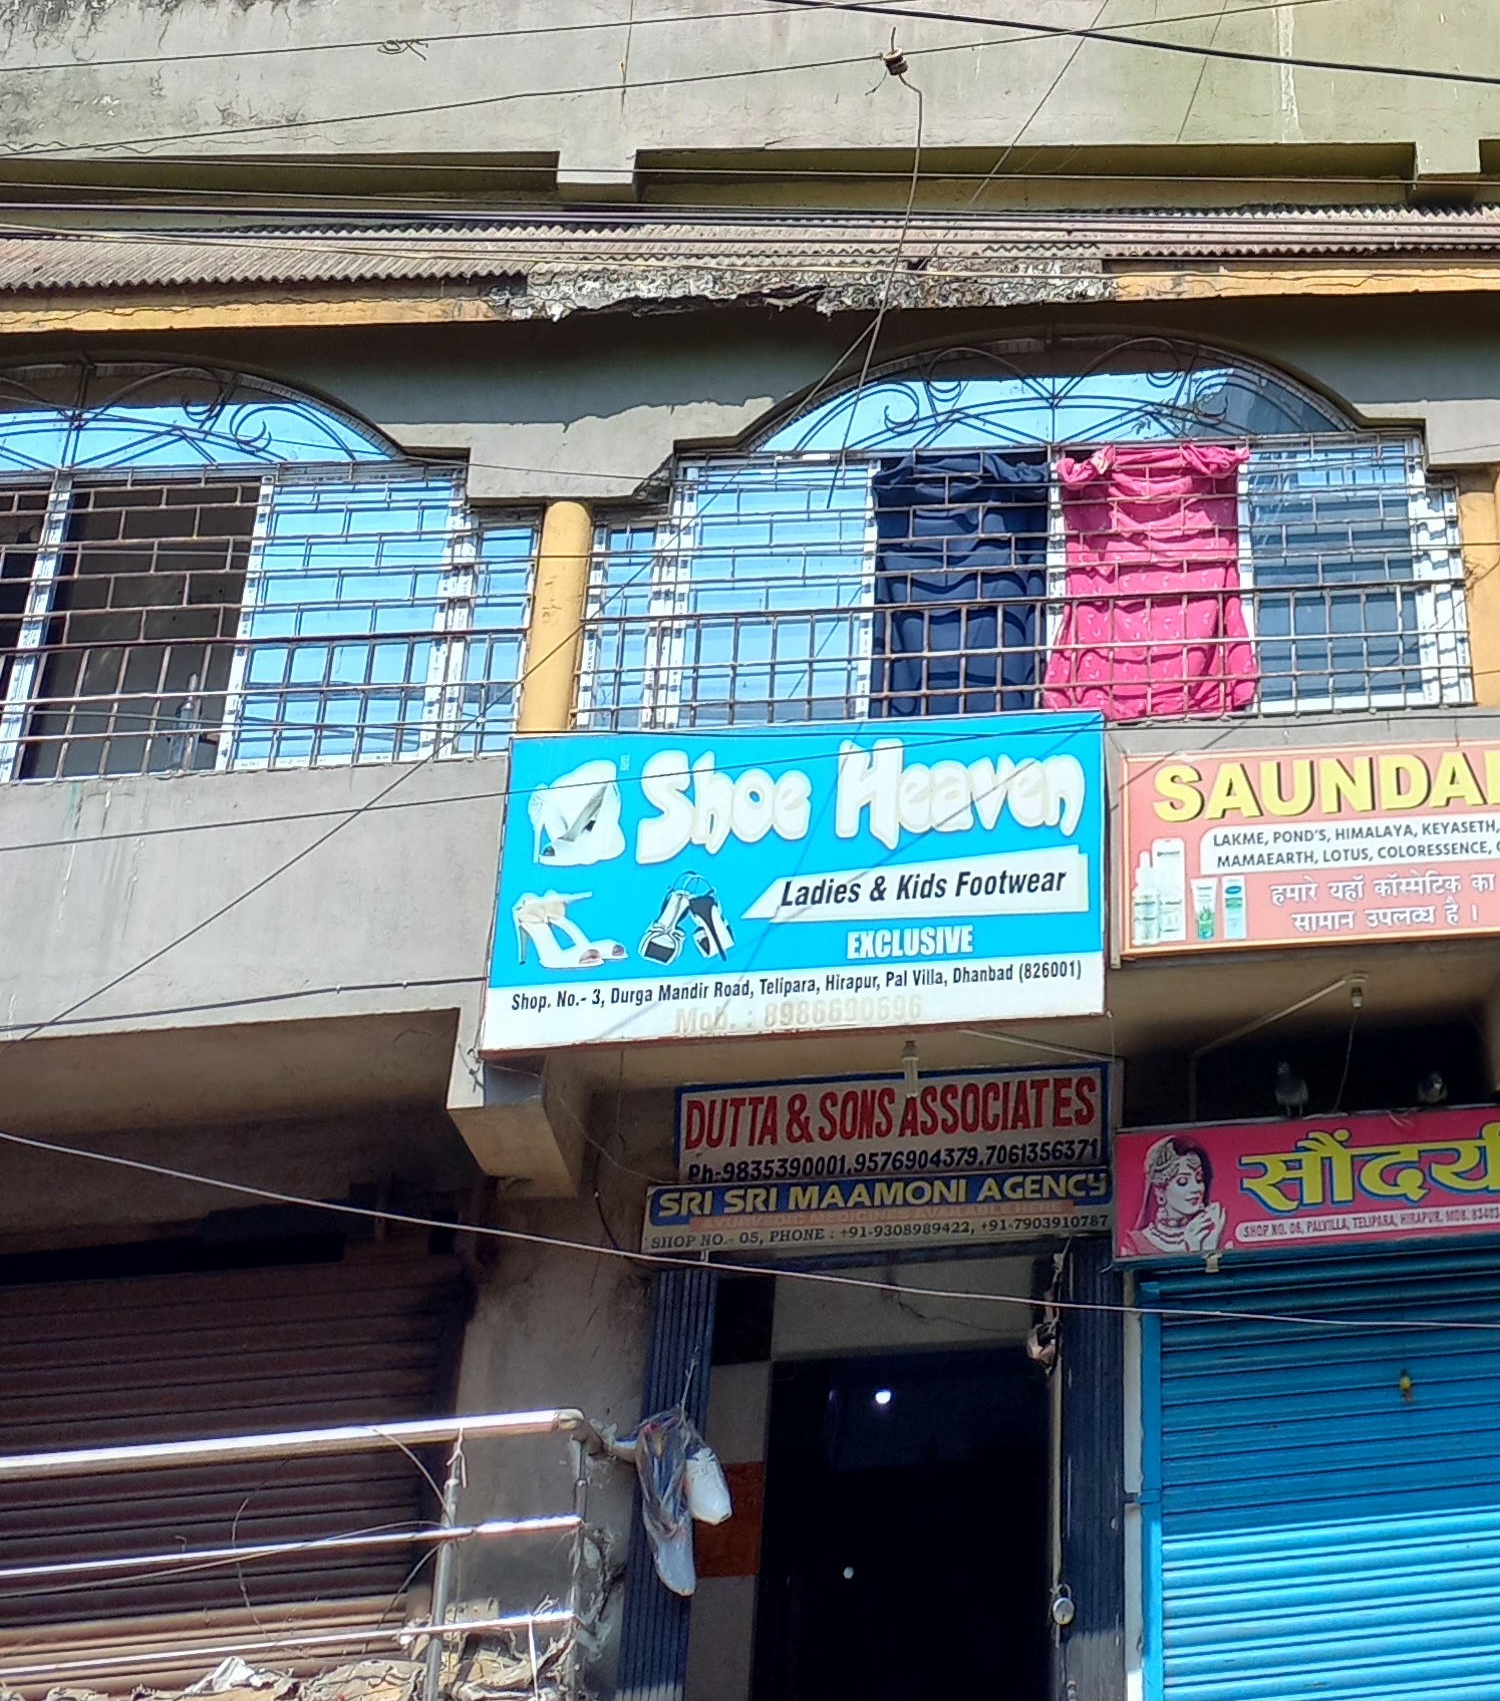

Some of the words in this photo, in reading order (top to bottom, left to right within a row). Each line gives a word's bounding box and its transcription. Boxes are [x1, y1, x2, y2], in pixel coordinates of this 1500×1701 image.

[636, 749, 812, 865] Shoe
[835, 738, 1086, 851] Heaven
[1213, 831, 1269, 847] LAKME,
[1335, 823, 1418, 841] HIMALAYA,
[1421, 819, 1500, 835] KEYASETH,
[1217, 850, 1318, 869] MAMAEARTH,
[1323, 847, 1373, 863] LOTUS,
[1377, 840, 1492, 859] COLORESSENCE,
[781, 876, 861, 908] Ladies
[869, 876, 887, 901] &
[896, 872, 947, 901] Kids
[955, 868, 1067, 898] Footwear
[1270, 874, 1319, 906] हमारे
[1470, 873, 1496, 893] का
[1291, 910, 1355, 932] सामान
[846, 925, 974, 960] EXCLUSIVE
[511, 992, 551, 1012] Shop.
[611, 986, 652, 1007] Durga
[658, 981, 709, 1002] Mandir
[713, 979, 754, 998] Road,
[760, 975, 820, 995] Telipara,
[825, 972, 880, 993] Hirapur,
[886, 970, 907, 988] Pal
[913, 967, 948, 987] Villa,
[953, 963, 1014, 983] Dhanbad
[1018, 959, 1082, 983] (826001)
[684, 1093, 778, 1151] DUTTA
[785, 1092, 812, 1143] &
[817, 1087, 896, 1141] SONS
[897, 1076, 1098, 1139] ASSOCIATES
[658, 1190, 713, 1218] SRI
[723, 1186, 777, 1214] SRI
[788, 1178, 968, 1211] MAAMONI
[976, 1173, 1107, 1202] AGENCY
[651, 1234, 696, 1249] SHOP
[769, 1228, 825, 1243] PHONE
